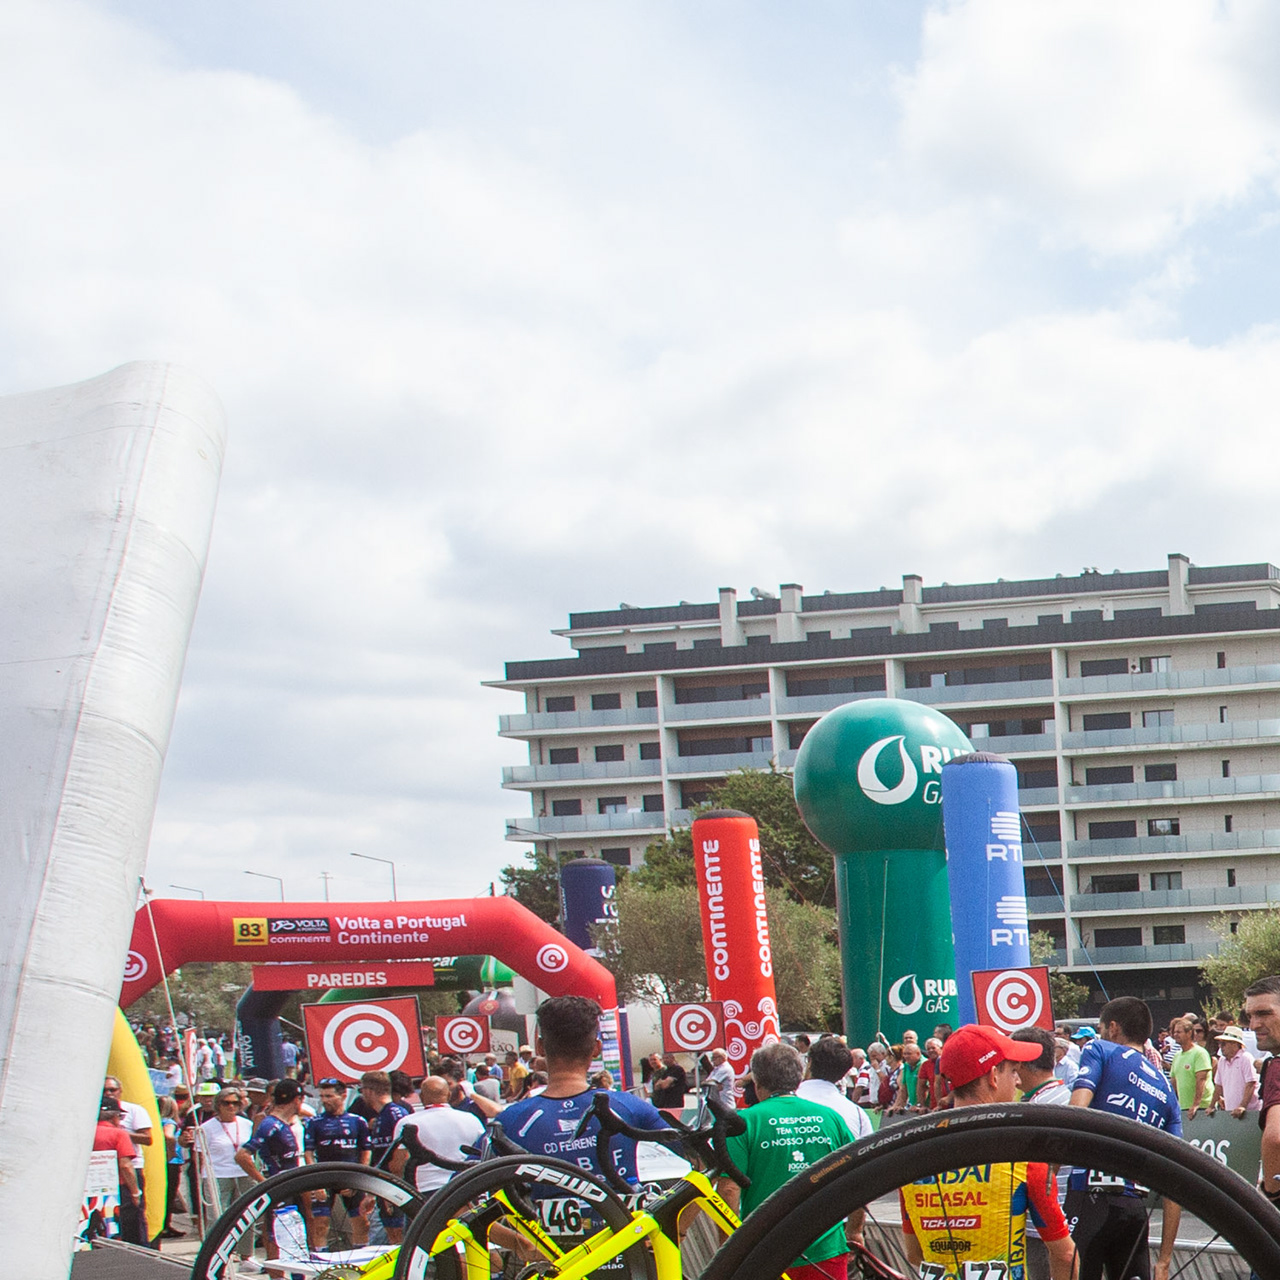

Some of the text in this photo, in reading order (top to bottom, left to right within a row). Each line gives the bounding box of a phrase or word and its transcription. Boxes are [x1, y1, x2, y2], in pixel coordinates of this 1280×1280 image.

[986, 843, 1023, 861] RT
[702, 839, 730, 981] CONTINENTE
[749, 837, 773, 978] CONTINENTE
[335, 914, 467, 931] Volta a Portugal
[338, 932, 429, 945] Continente
[991, 928, 1029, 946] RT
[307, 971, 388, 988] PAREDES
[925, 979, 957, 996] RUB
[926, 996, 950, 1014] GÁS
[1137, 1077, 1168, 1104] FEIRENSE
[768, 1115, 824, 1126] O DESPORTO
[776, 1125, 821, 1135] TEM TODO
[560, 1135, 599, 1152] FEIRENS
[760, 1136, 832, 1149] O NOSSO APOIO
[515, 1163, 608, 1203] FFWD
[915, 1191, 988, 1208] SICASAL
[922, 1218, 977, 1229] TCHACO
[929, 1240, 973, 1252] EQUADOR
